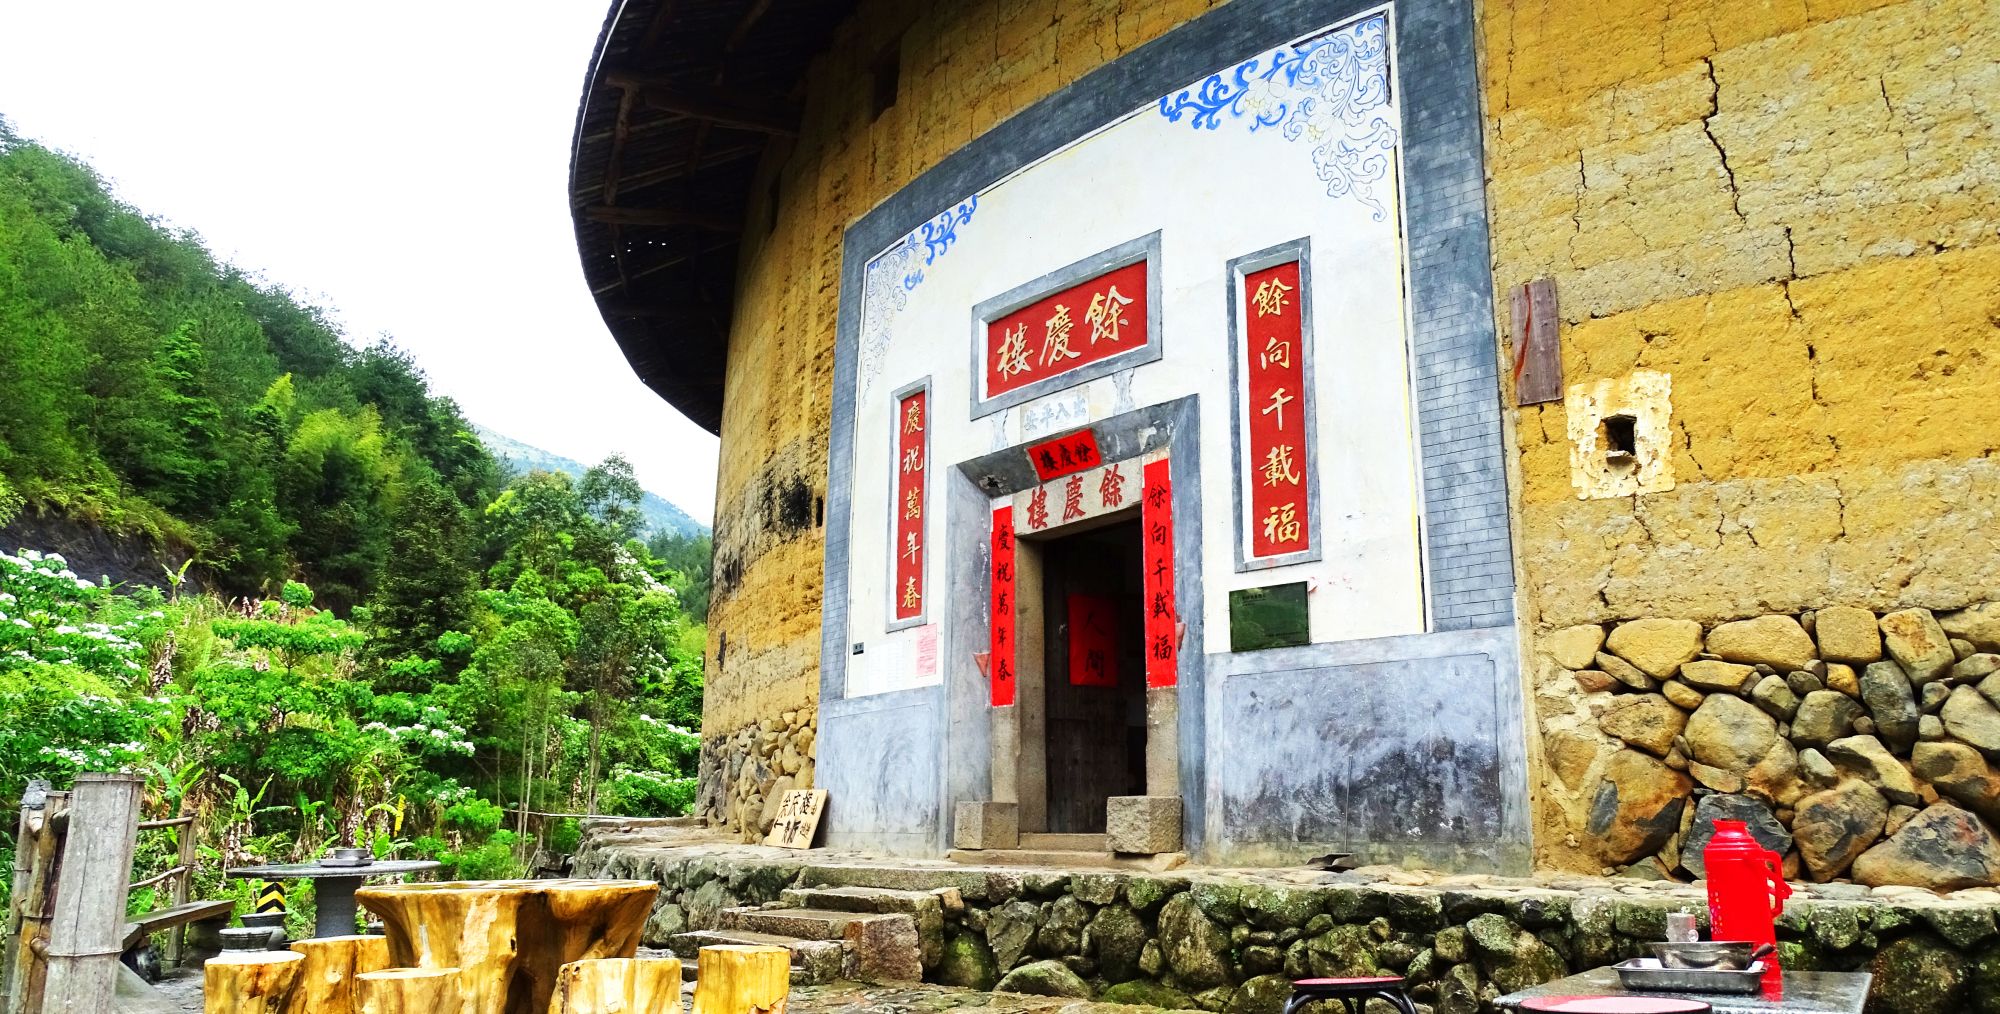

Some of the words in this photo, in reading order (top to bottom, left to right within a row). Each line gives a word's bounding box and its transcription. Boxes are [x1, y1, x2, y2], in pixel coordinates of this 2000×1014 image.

[902, 400, 924, 609] 慶祝萬年春
[1252, 277, 1301, 544] 餘向千載福
